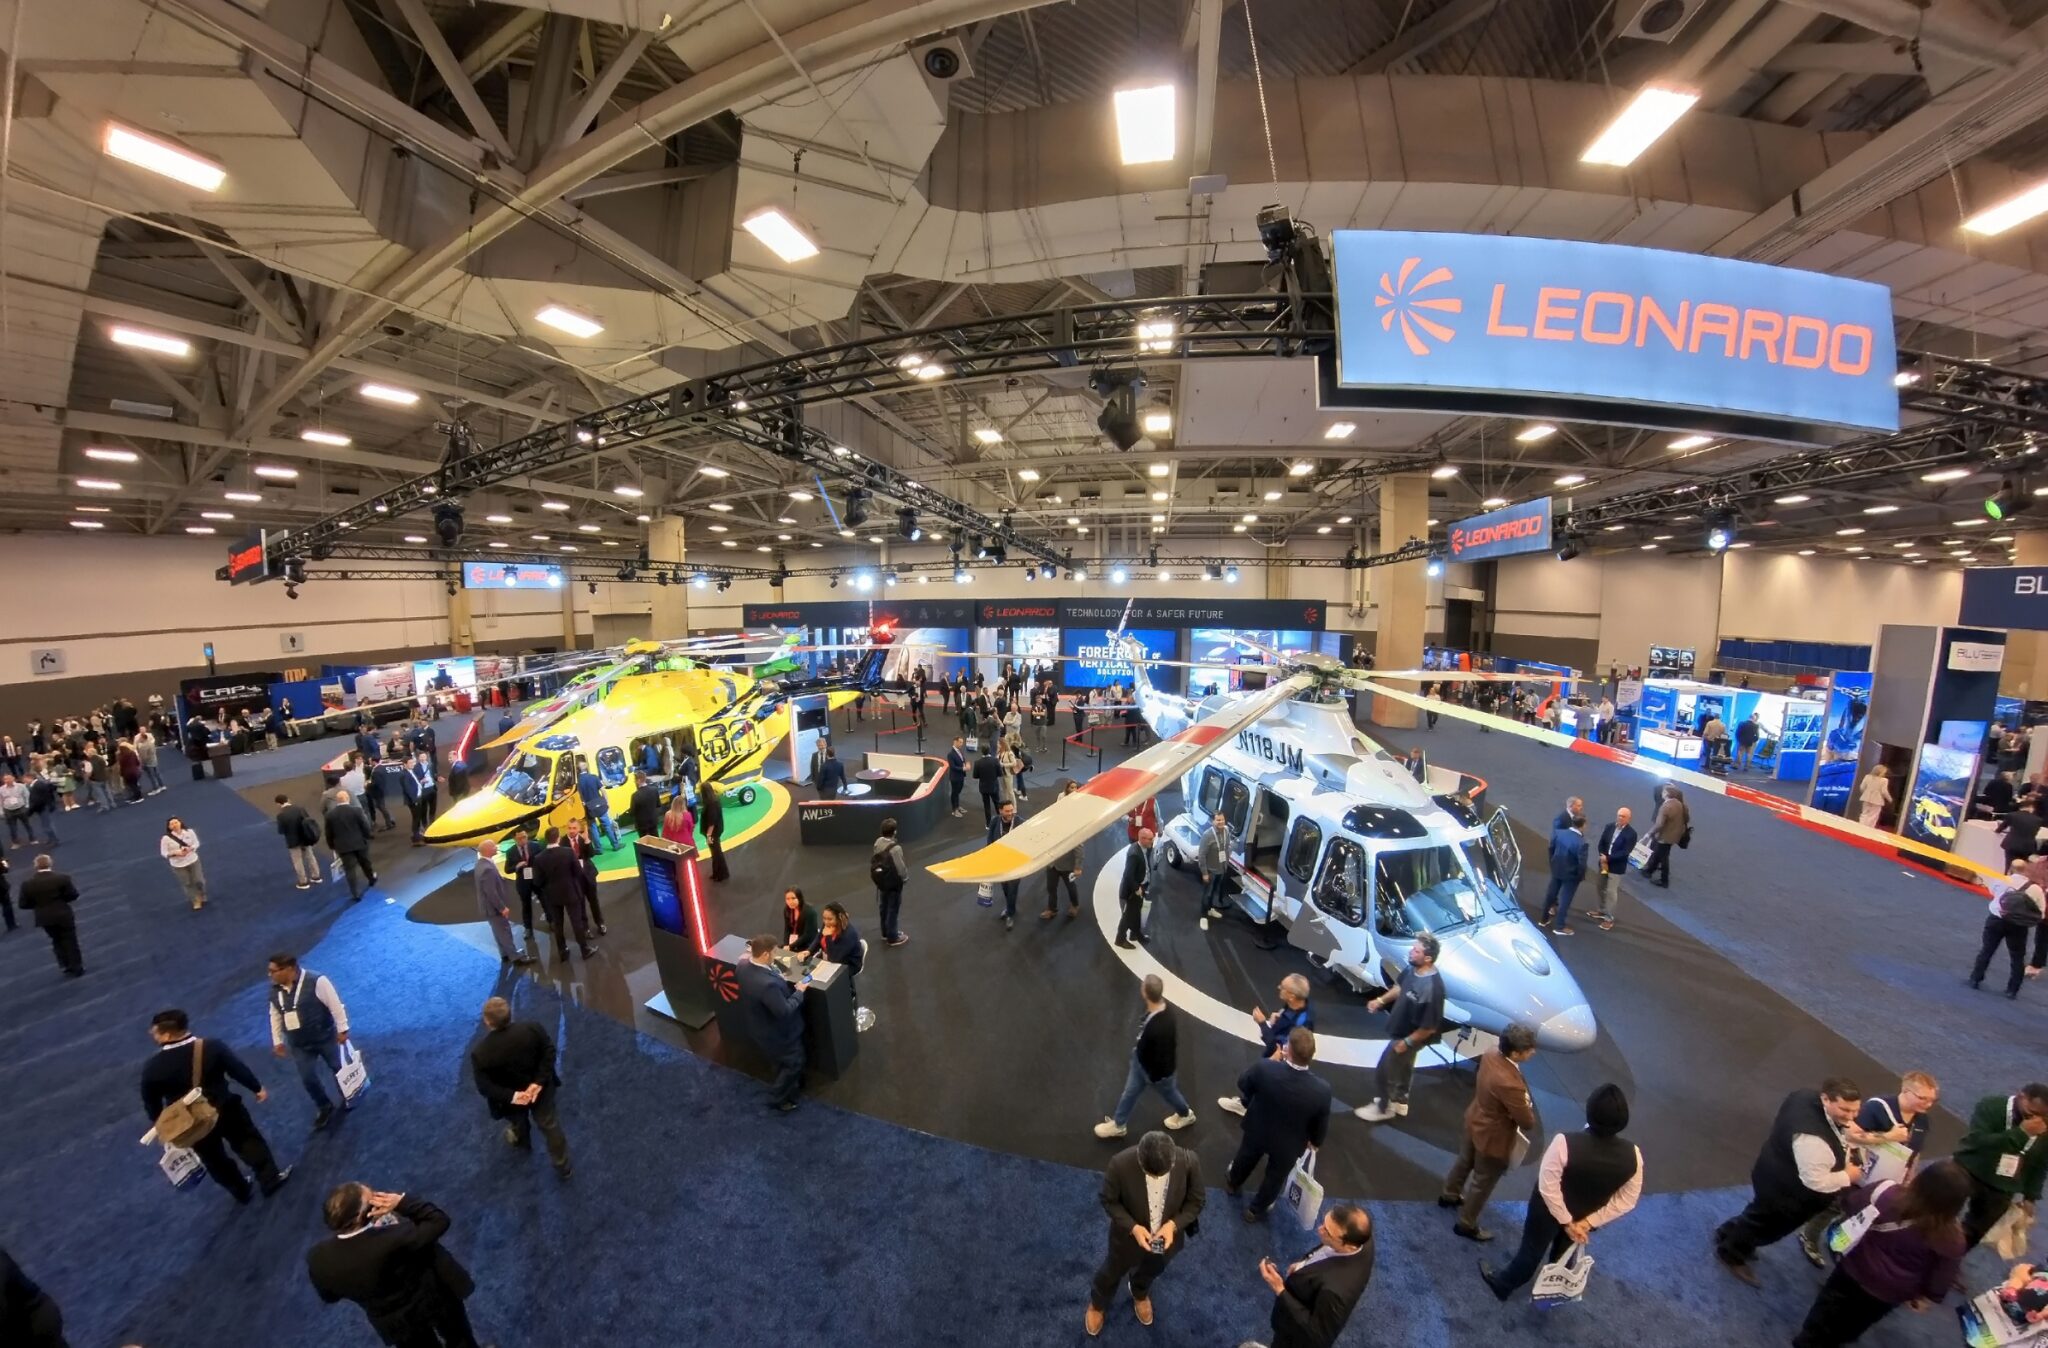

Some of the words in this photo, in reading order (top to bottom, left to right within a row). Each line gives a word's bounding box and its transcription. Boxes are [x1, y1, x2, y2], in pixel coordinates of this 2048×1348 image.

[1486, 283, 1873, 376] LEONARDO
[1464, 514, 1542, 550] LEONARDO
[996, 607, 1055, 617] LEONARDO
[1066, 608, 1123, 618] TECHNOLOGY
[1146, 608, 1153, 618] A
[1156, 608, 1185, 618] SAFER
[1188, 609, 1224, 619] FUTURE
[1078, 646, 1149, 659] FOREFROT
[1096, 668, 1133, 676] SOLUTIO
[1239, 730, 1303, 774] N118JM
[802, 808, 833, 821] AW139
